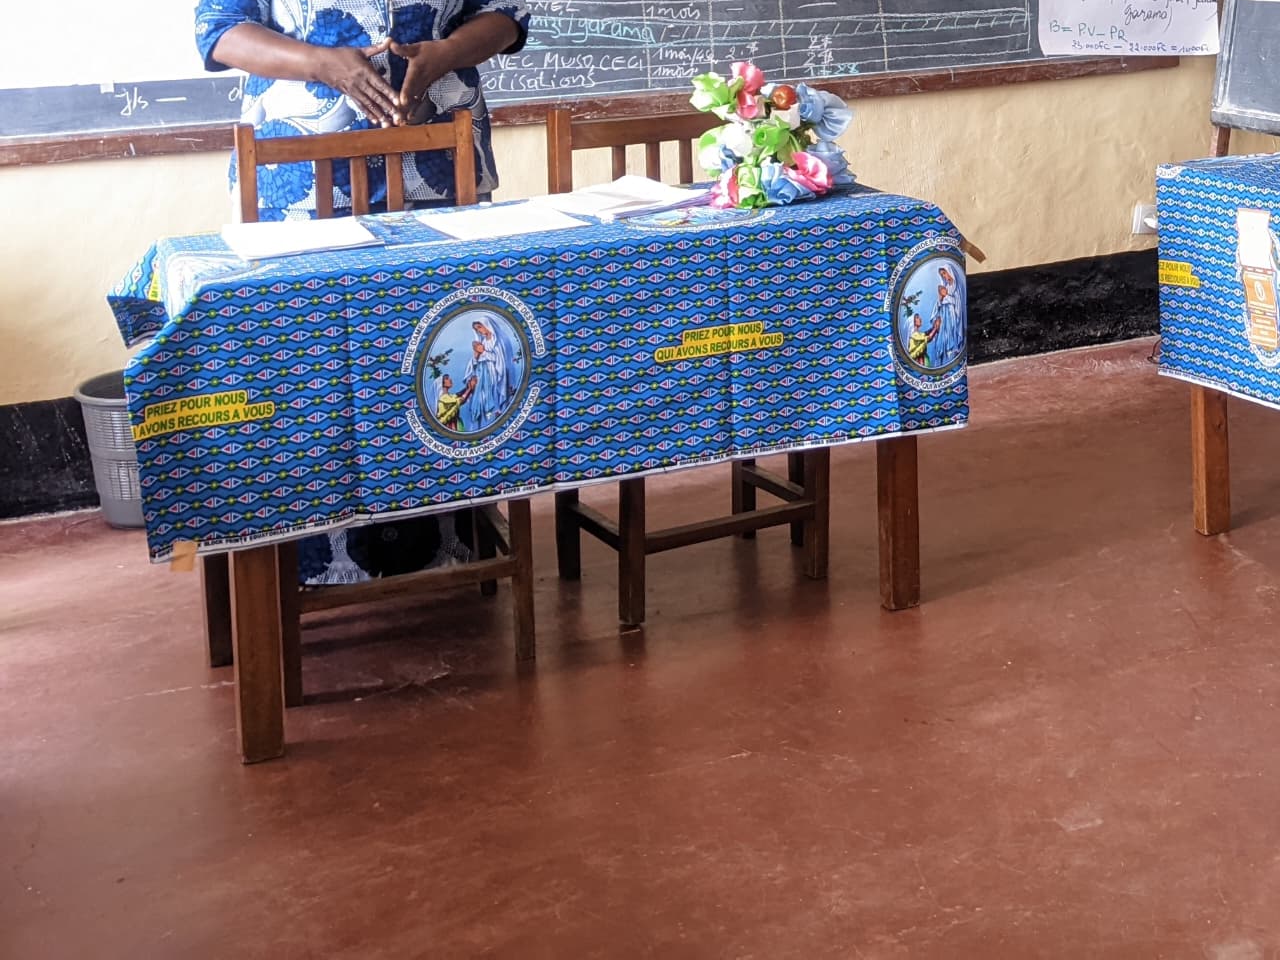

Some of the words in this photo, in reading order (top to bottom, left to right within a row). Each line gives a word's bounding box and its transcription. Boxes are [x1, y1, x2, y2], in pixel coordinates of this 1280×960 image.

[684, 330, 709, 342] PRIEZ
[712, 326, 735, 338] POUR
[738, 322, 761, 335] NOUS
[676, 344, 708, 357] AVONS
[710, 338, 749, 353] RECOURS
[760, 334, 782, 346] VOUS
[146, 403, 177, 419] PRIEZ
[180, 397, 211, 411] POUR
[214, 391, 245, 406] NOUS
[139, 420, 175, 437] AVONS
[177, 411, 230, 428] RECOURS
[243, 404, 273, 418] VOUS
